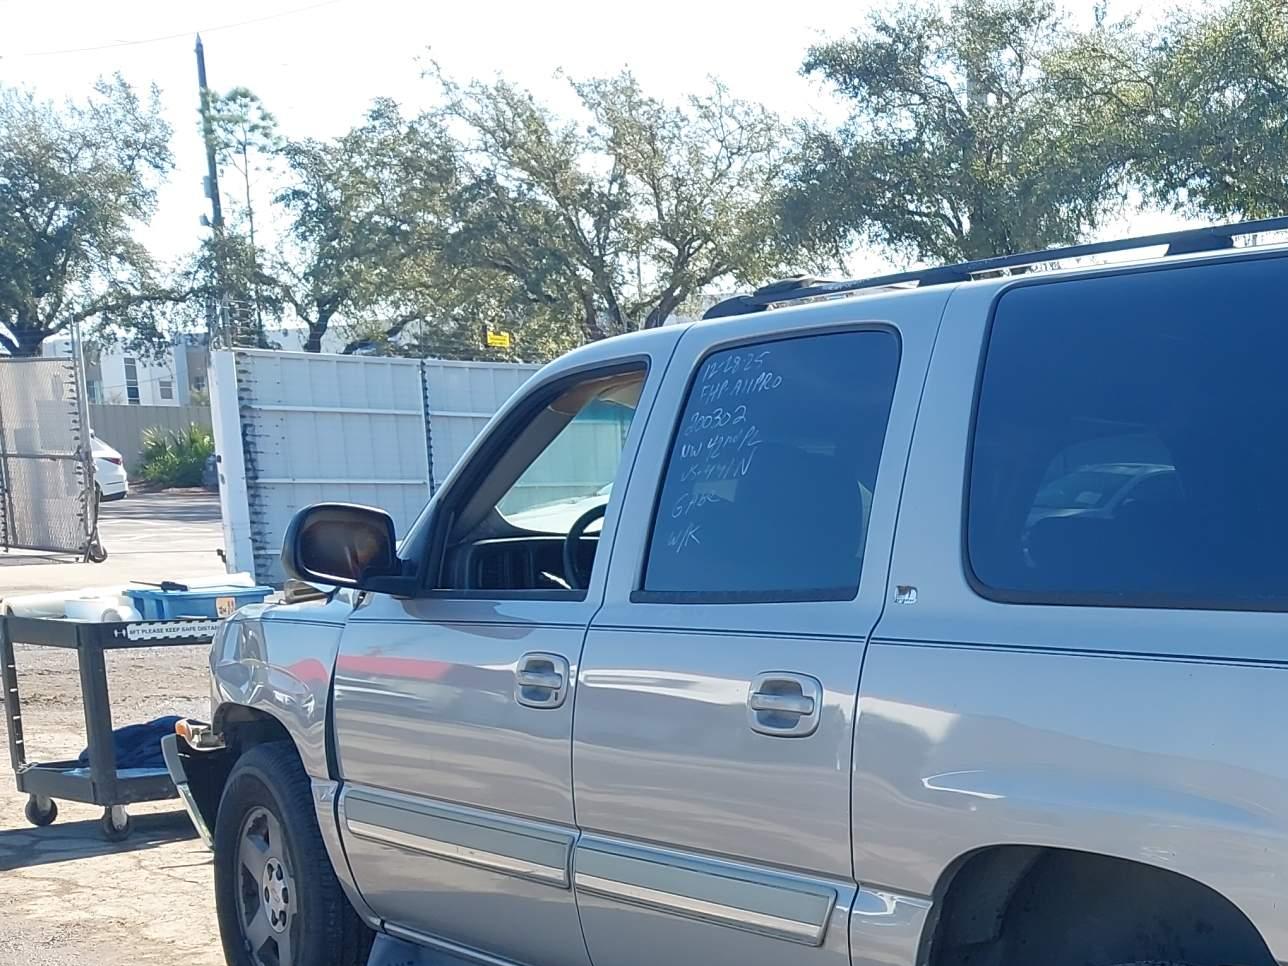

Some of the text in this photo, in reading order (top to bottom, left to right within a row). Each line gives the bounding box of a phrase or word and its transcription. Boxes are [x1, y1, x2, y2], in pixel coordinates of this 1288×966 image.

[141, 627, 164, 635] PLEASE
[165, 626, 180, 634] KEEP
[181, 625, 196, 633] SAFE
